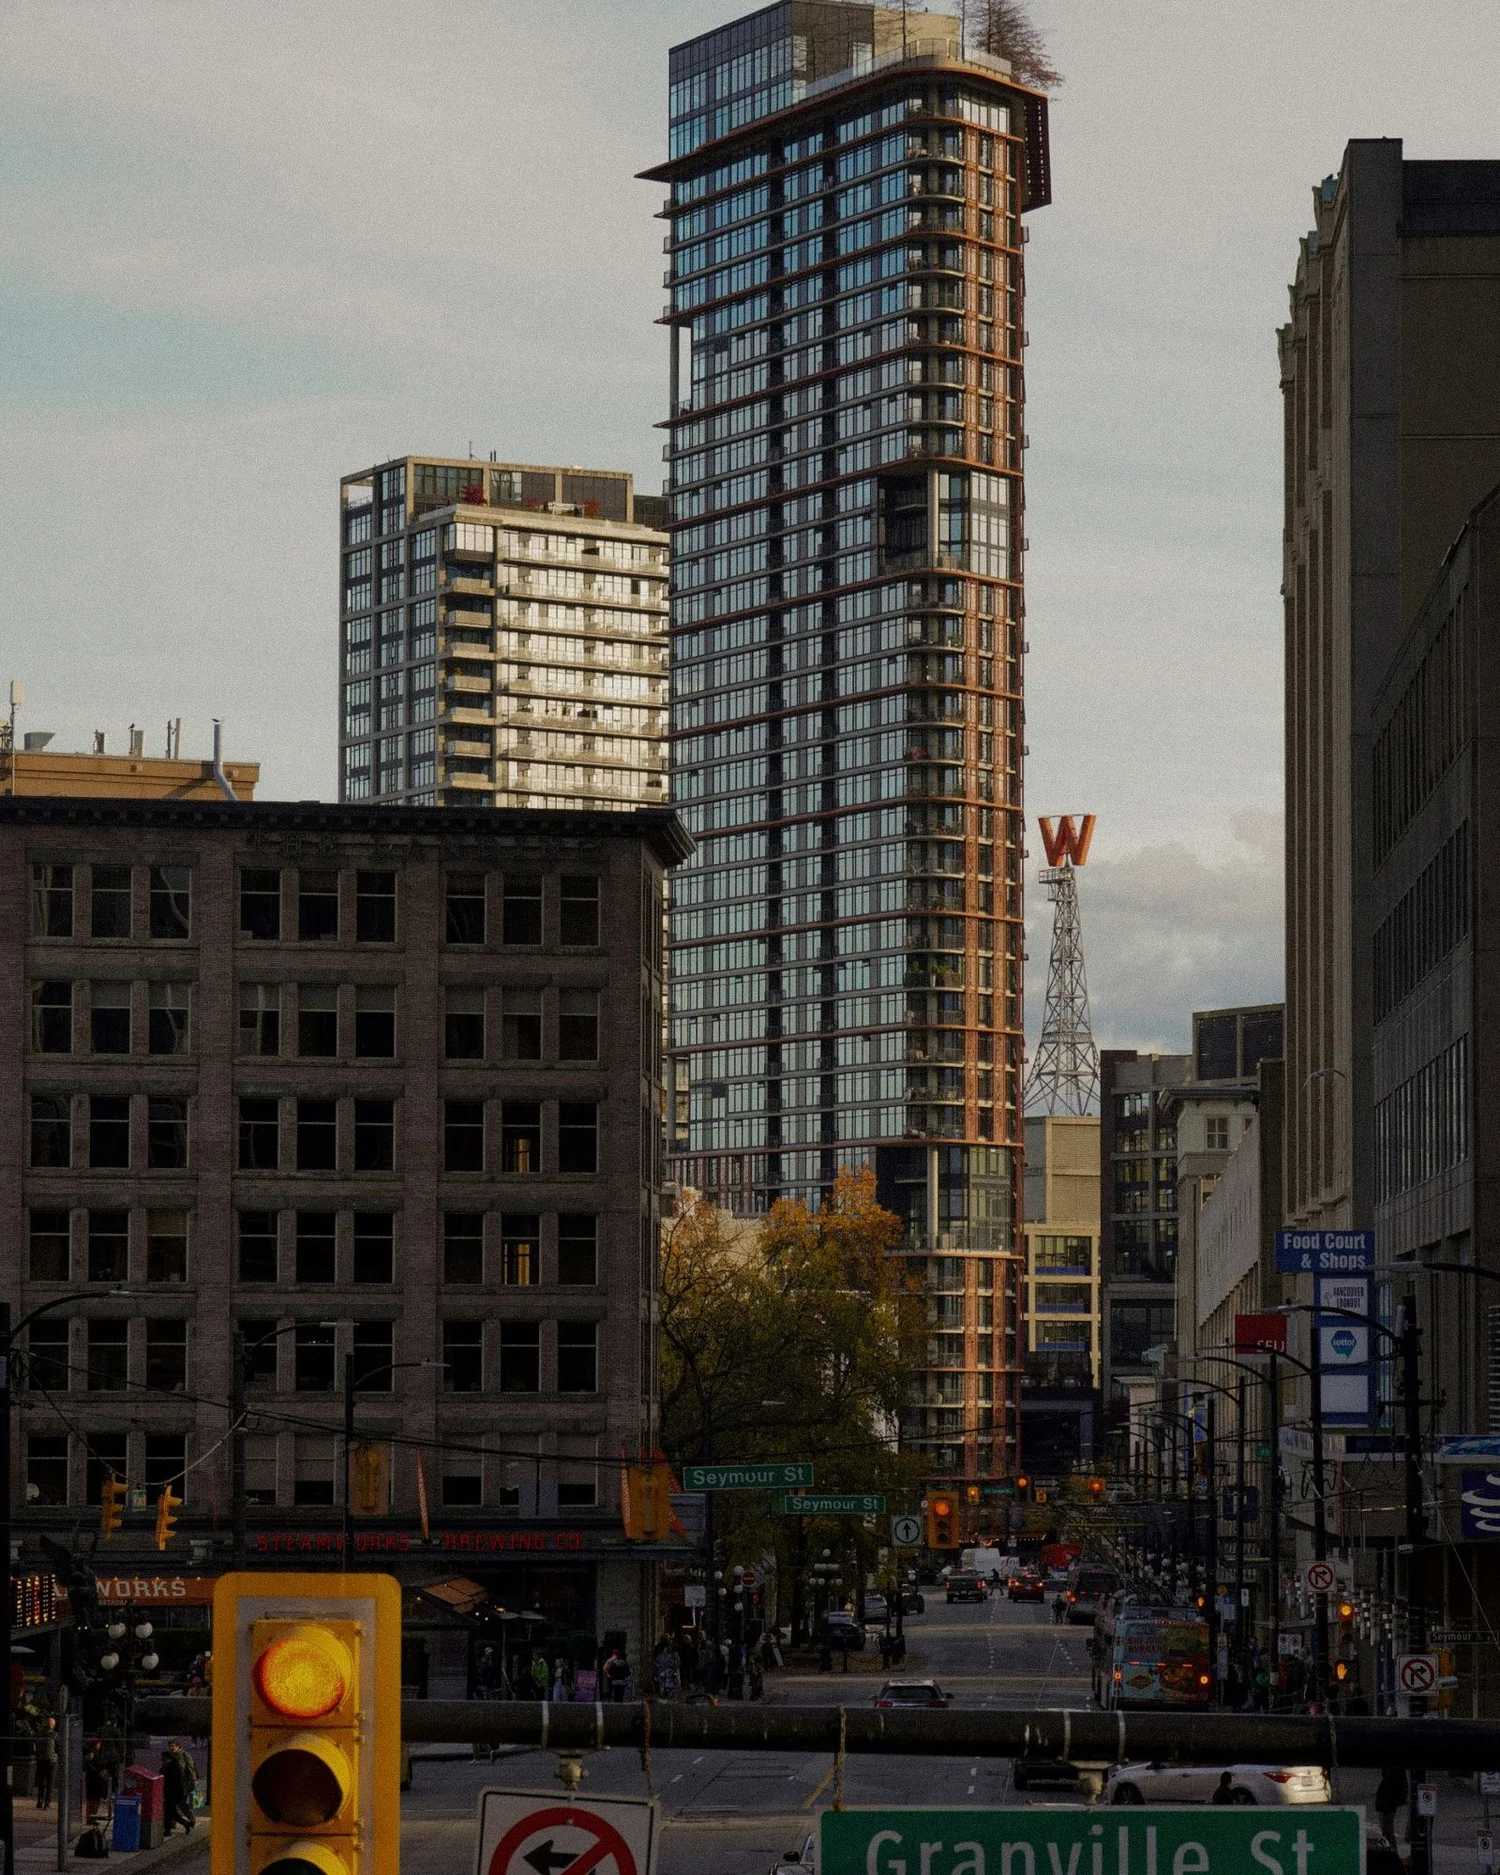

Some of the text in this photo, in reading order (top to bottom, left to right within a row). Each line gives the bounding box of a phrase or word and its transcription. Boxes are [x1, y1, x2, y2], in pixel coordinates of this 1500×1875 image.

[1039, 815, 1095, 866] W
[1283, 1233, 1366, 1249] Food Court
[1300, 1252, 1366, 1271] & Shops
[693, 1467, 805, 1487] Seymour St
[792, 1497, 878, 1511] Seymour St
[866, 1824, 1315, 1875] Granville St
